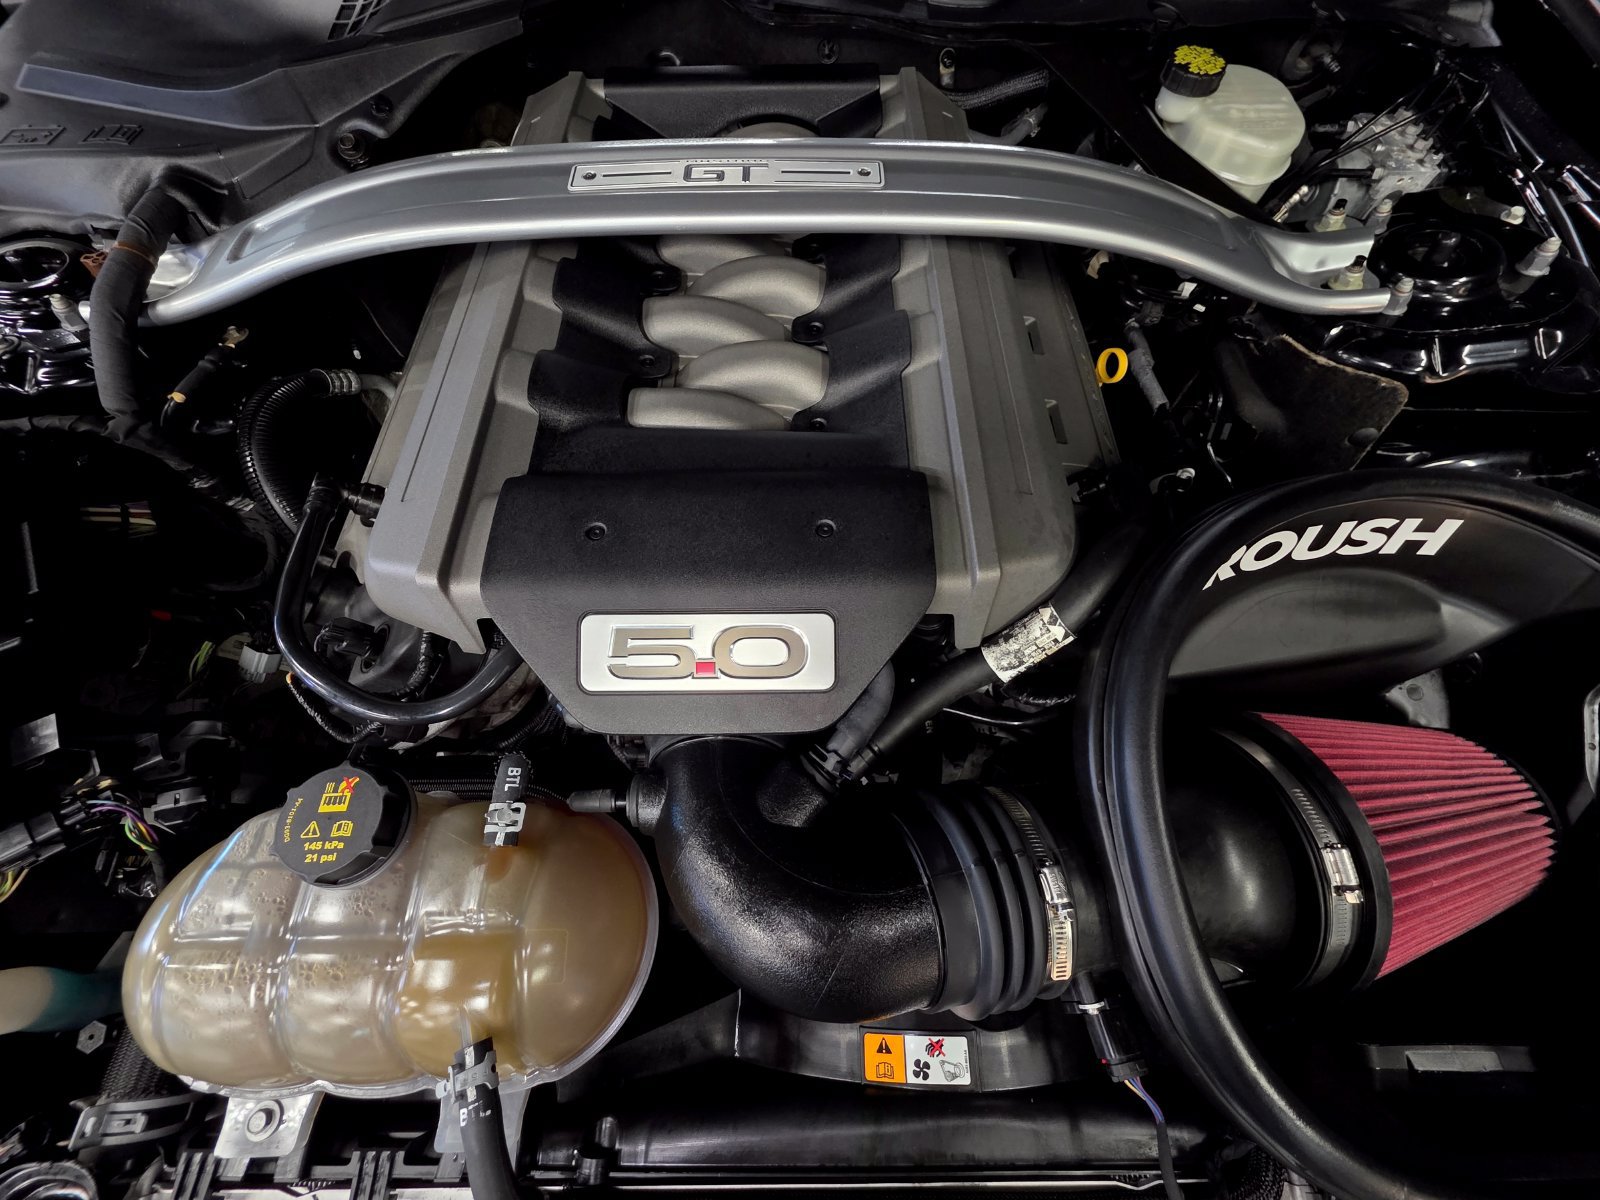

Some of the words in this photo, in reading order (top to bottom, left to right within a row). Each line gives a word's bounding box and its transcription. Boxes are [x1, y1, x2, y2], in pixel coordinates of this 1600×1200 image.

[683, 163, 769, 183] GT
[607, 624, 810, 680] 5.0
[504, 767, 522, 792] BTL
[303, 841, 323, 851] 145
[324, 840, 345, 850] kPa
[304, 853, 318, 863] 21
[319, 852, 338, 864] psi
